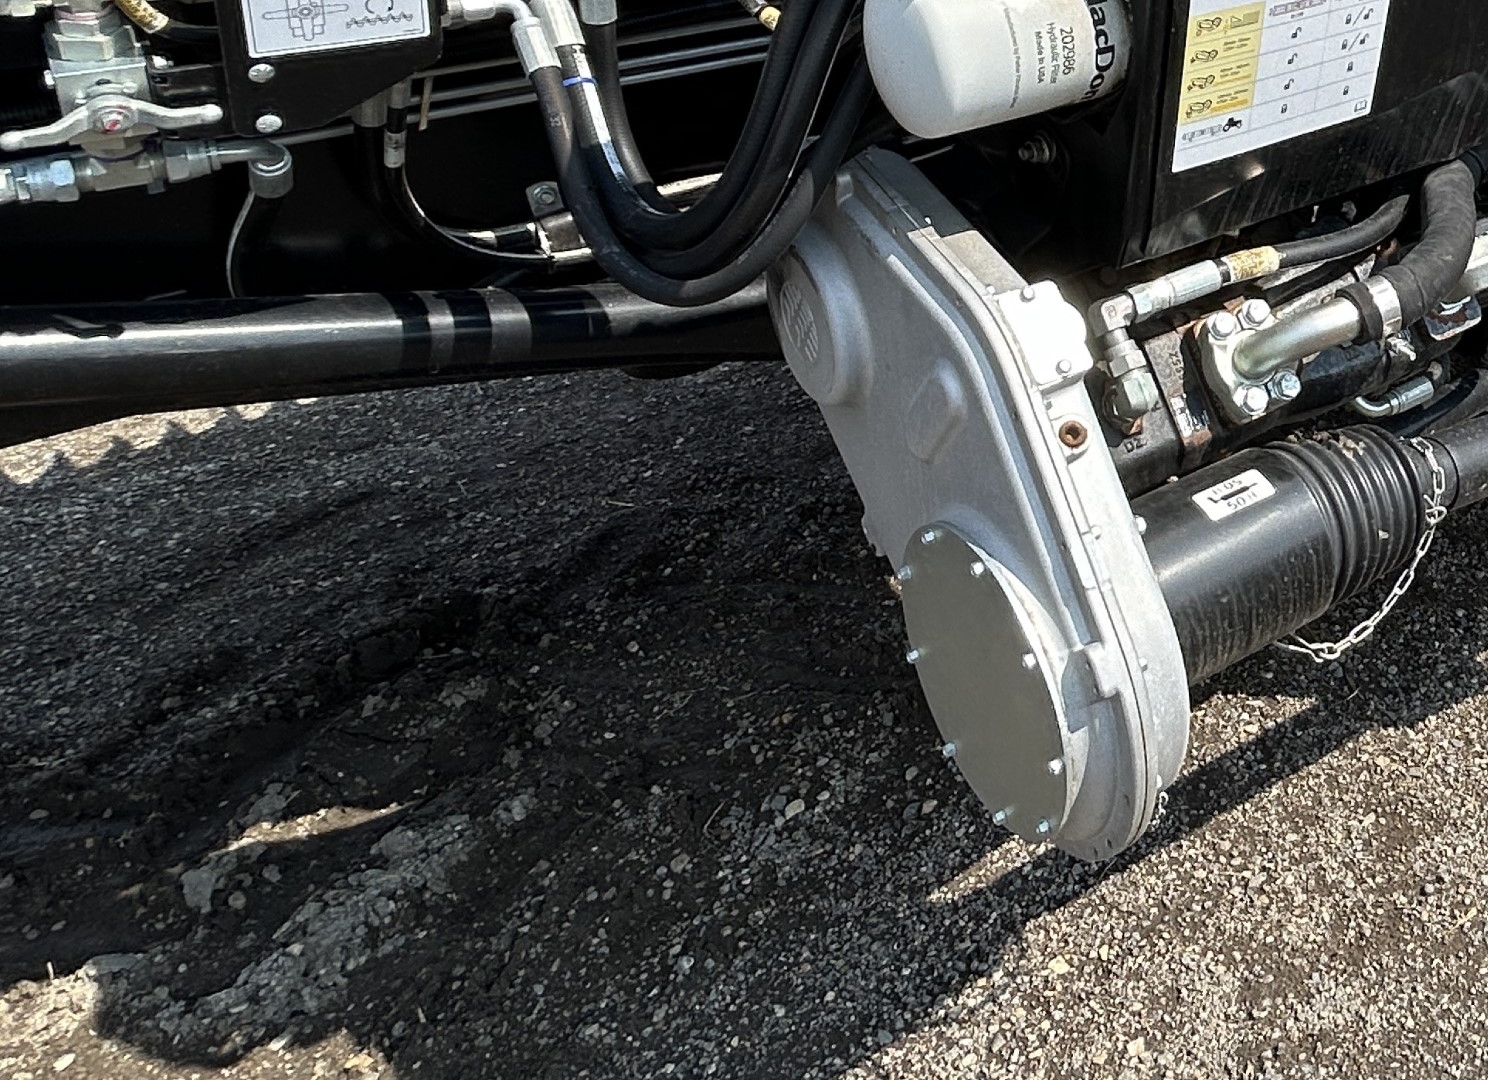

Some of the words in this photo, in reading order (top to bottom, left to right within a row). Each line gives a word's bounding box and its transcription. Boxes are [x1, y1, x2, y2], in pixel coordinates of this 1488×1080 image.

[1035, 31, 1045, 55] Made
[1046, 22, 1060, 63] Hydraulic
[1060, 26, 1075, 75] 202986
[1037, 67, 1046, 84] USA
